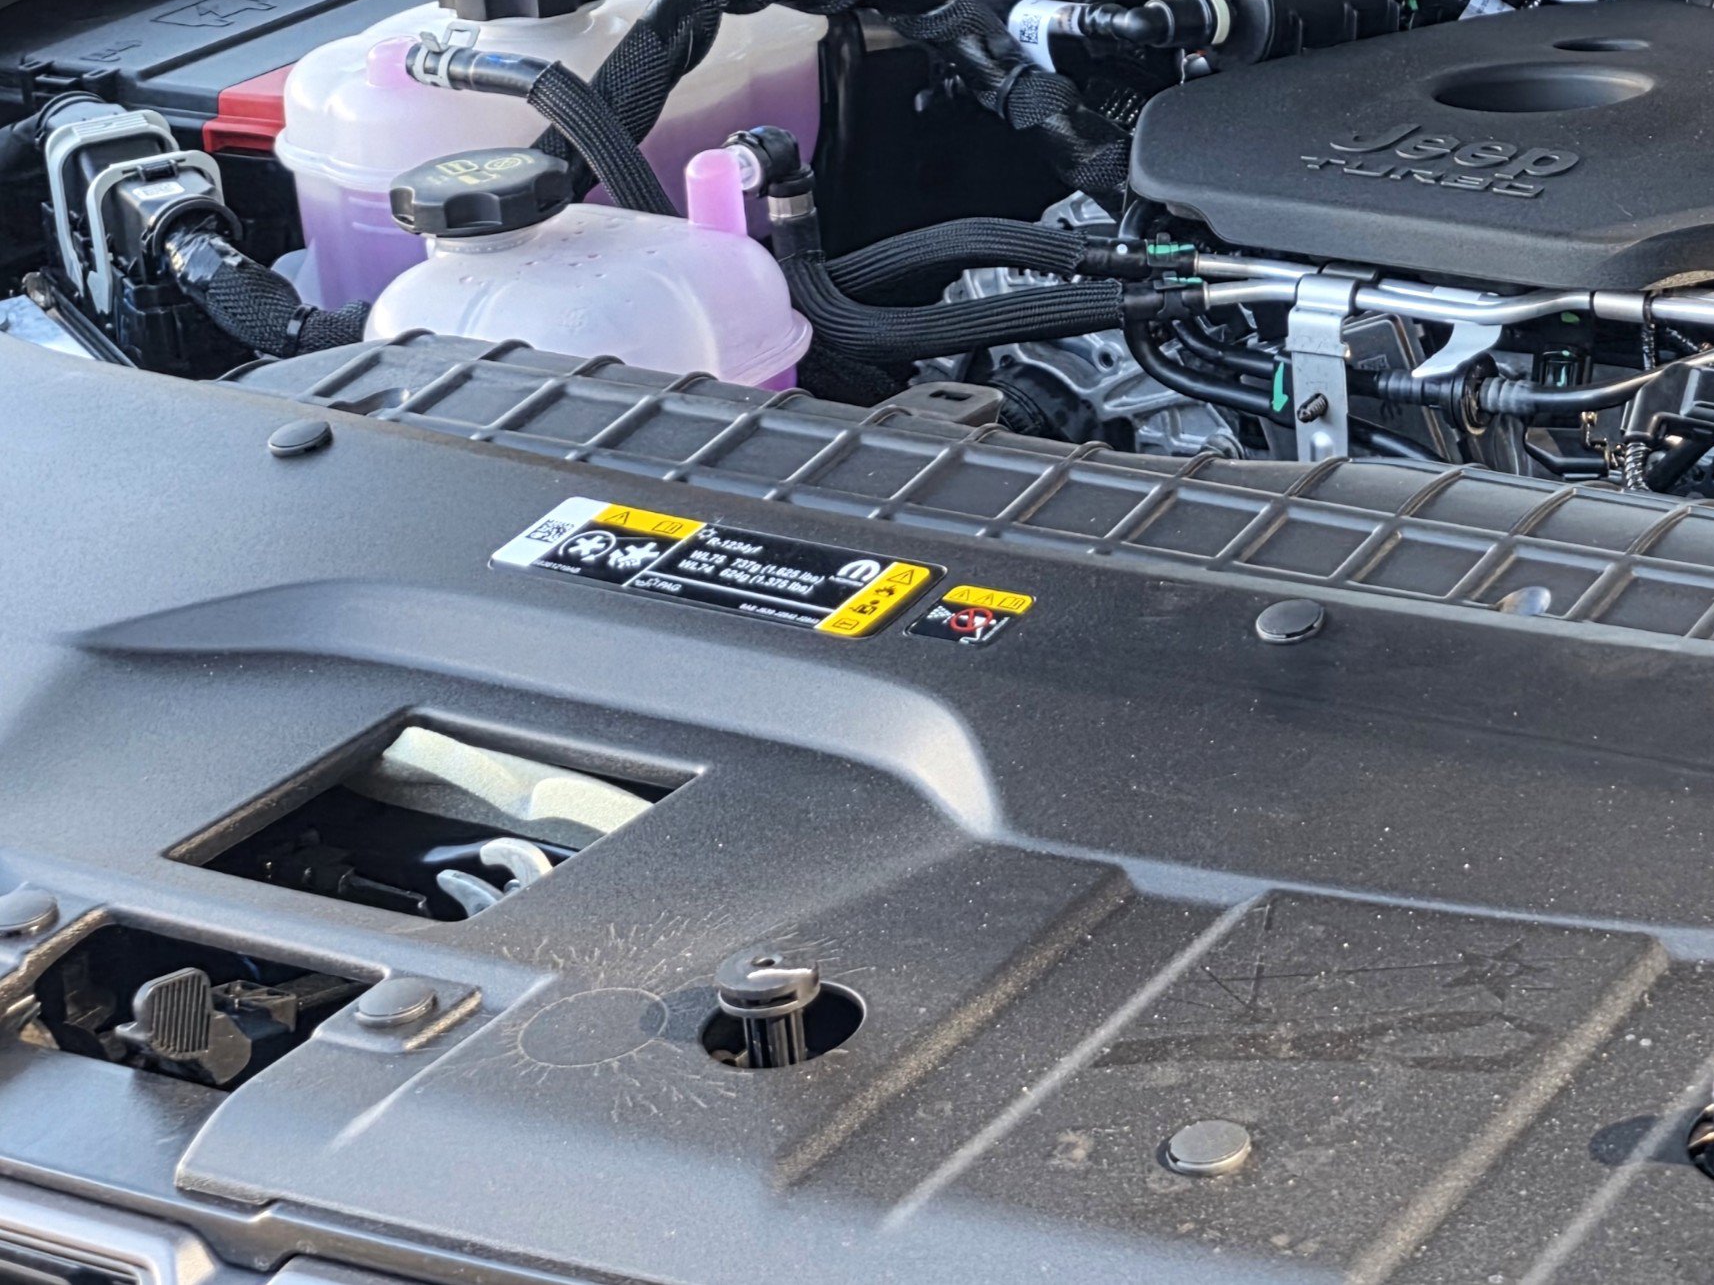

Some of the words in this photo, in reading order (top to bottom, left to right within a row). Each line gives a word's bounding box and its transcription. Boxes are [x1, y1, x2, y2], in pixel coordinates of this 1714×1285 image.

[1330, 123, 1580, 179] Jeep
[706, 537, 763, 554] R-1234yf
[659, 580, 682, 592] PAG
